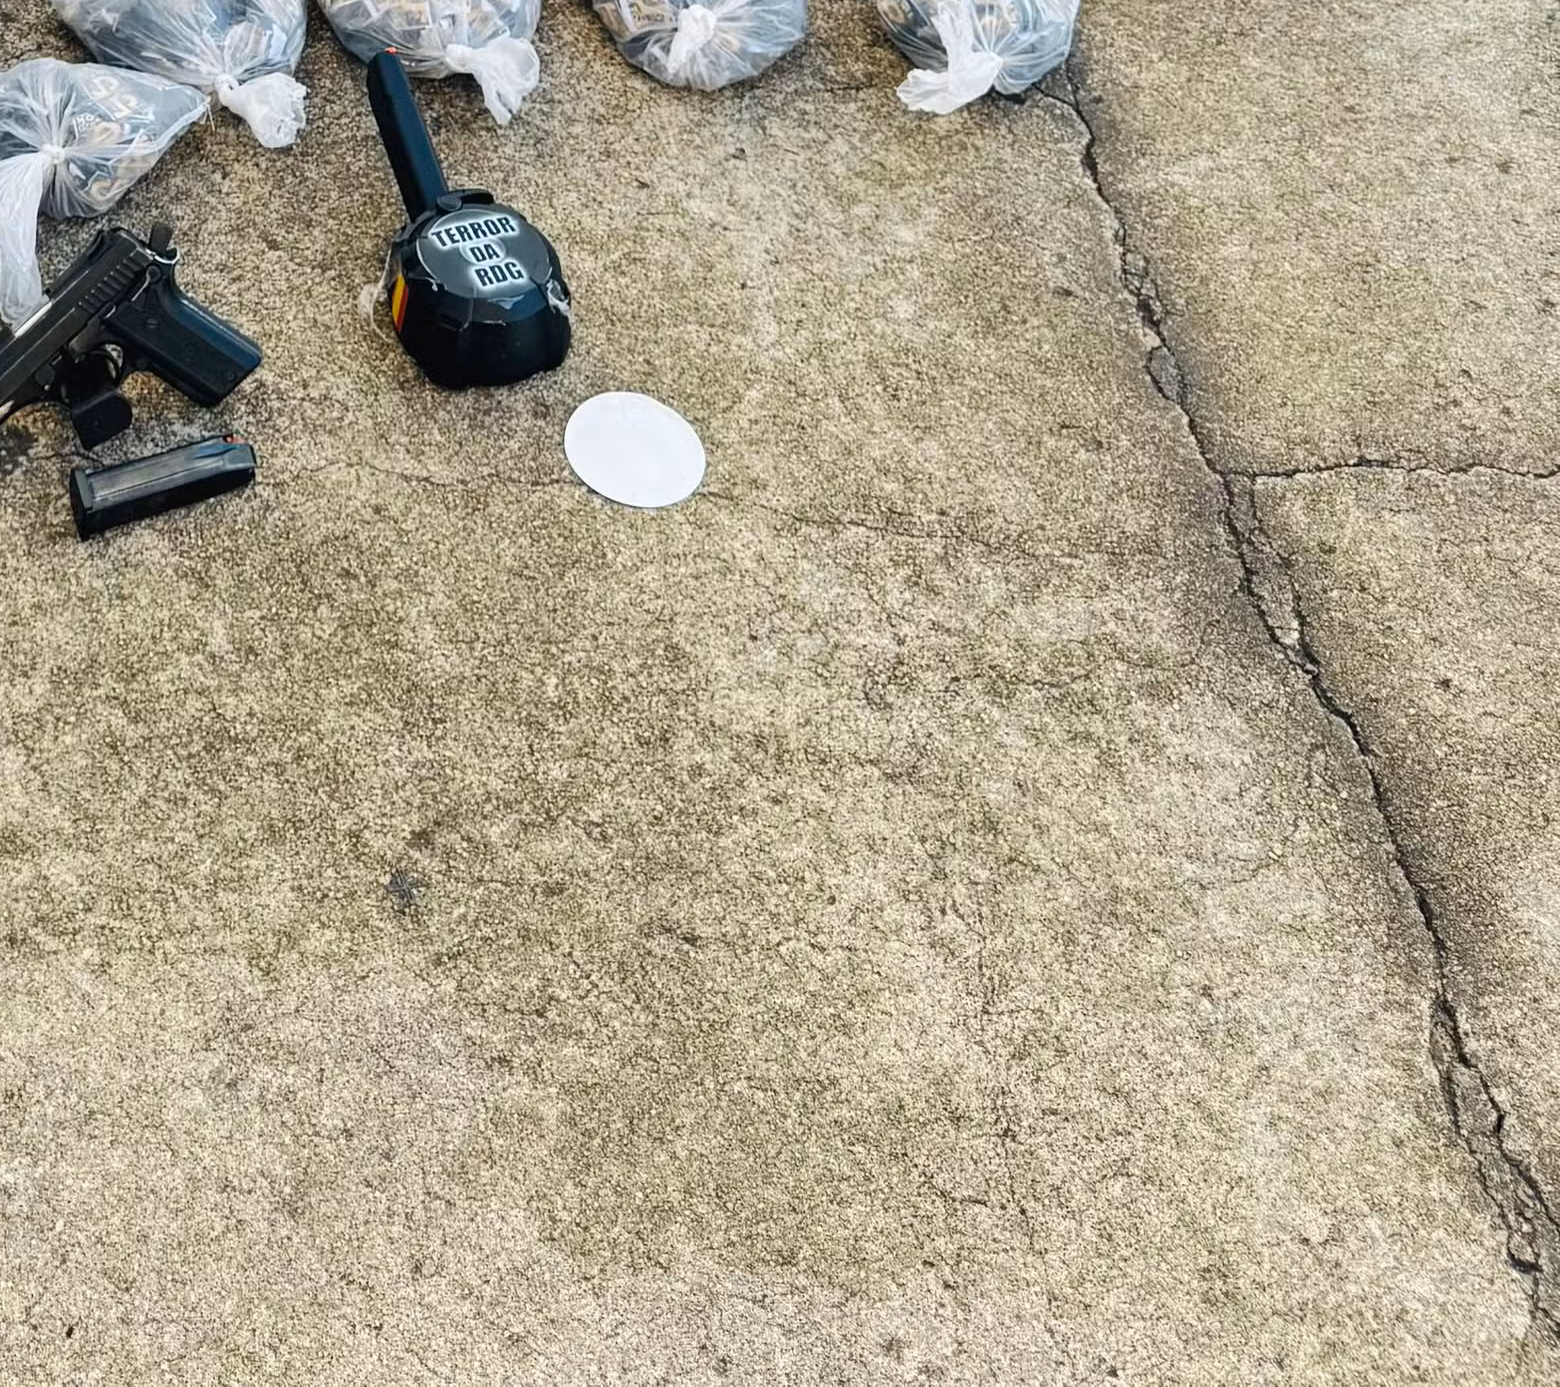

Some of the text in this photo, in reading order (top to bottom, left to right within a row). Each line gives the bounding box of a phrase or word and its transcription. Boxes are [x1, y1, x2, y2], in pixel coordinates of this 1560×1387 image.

[431, 216, 516, 248] TERROR
[469, 245, 501, 263] DA
[474, 261, 525, 288] RDG
